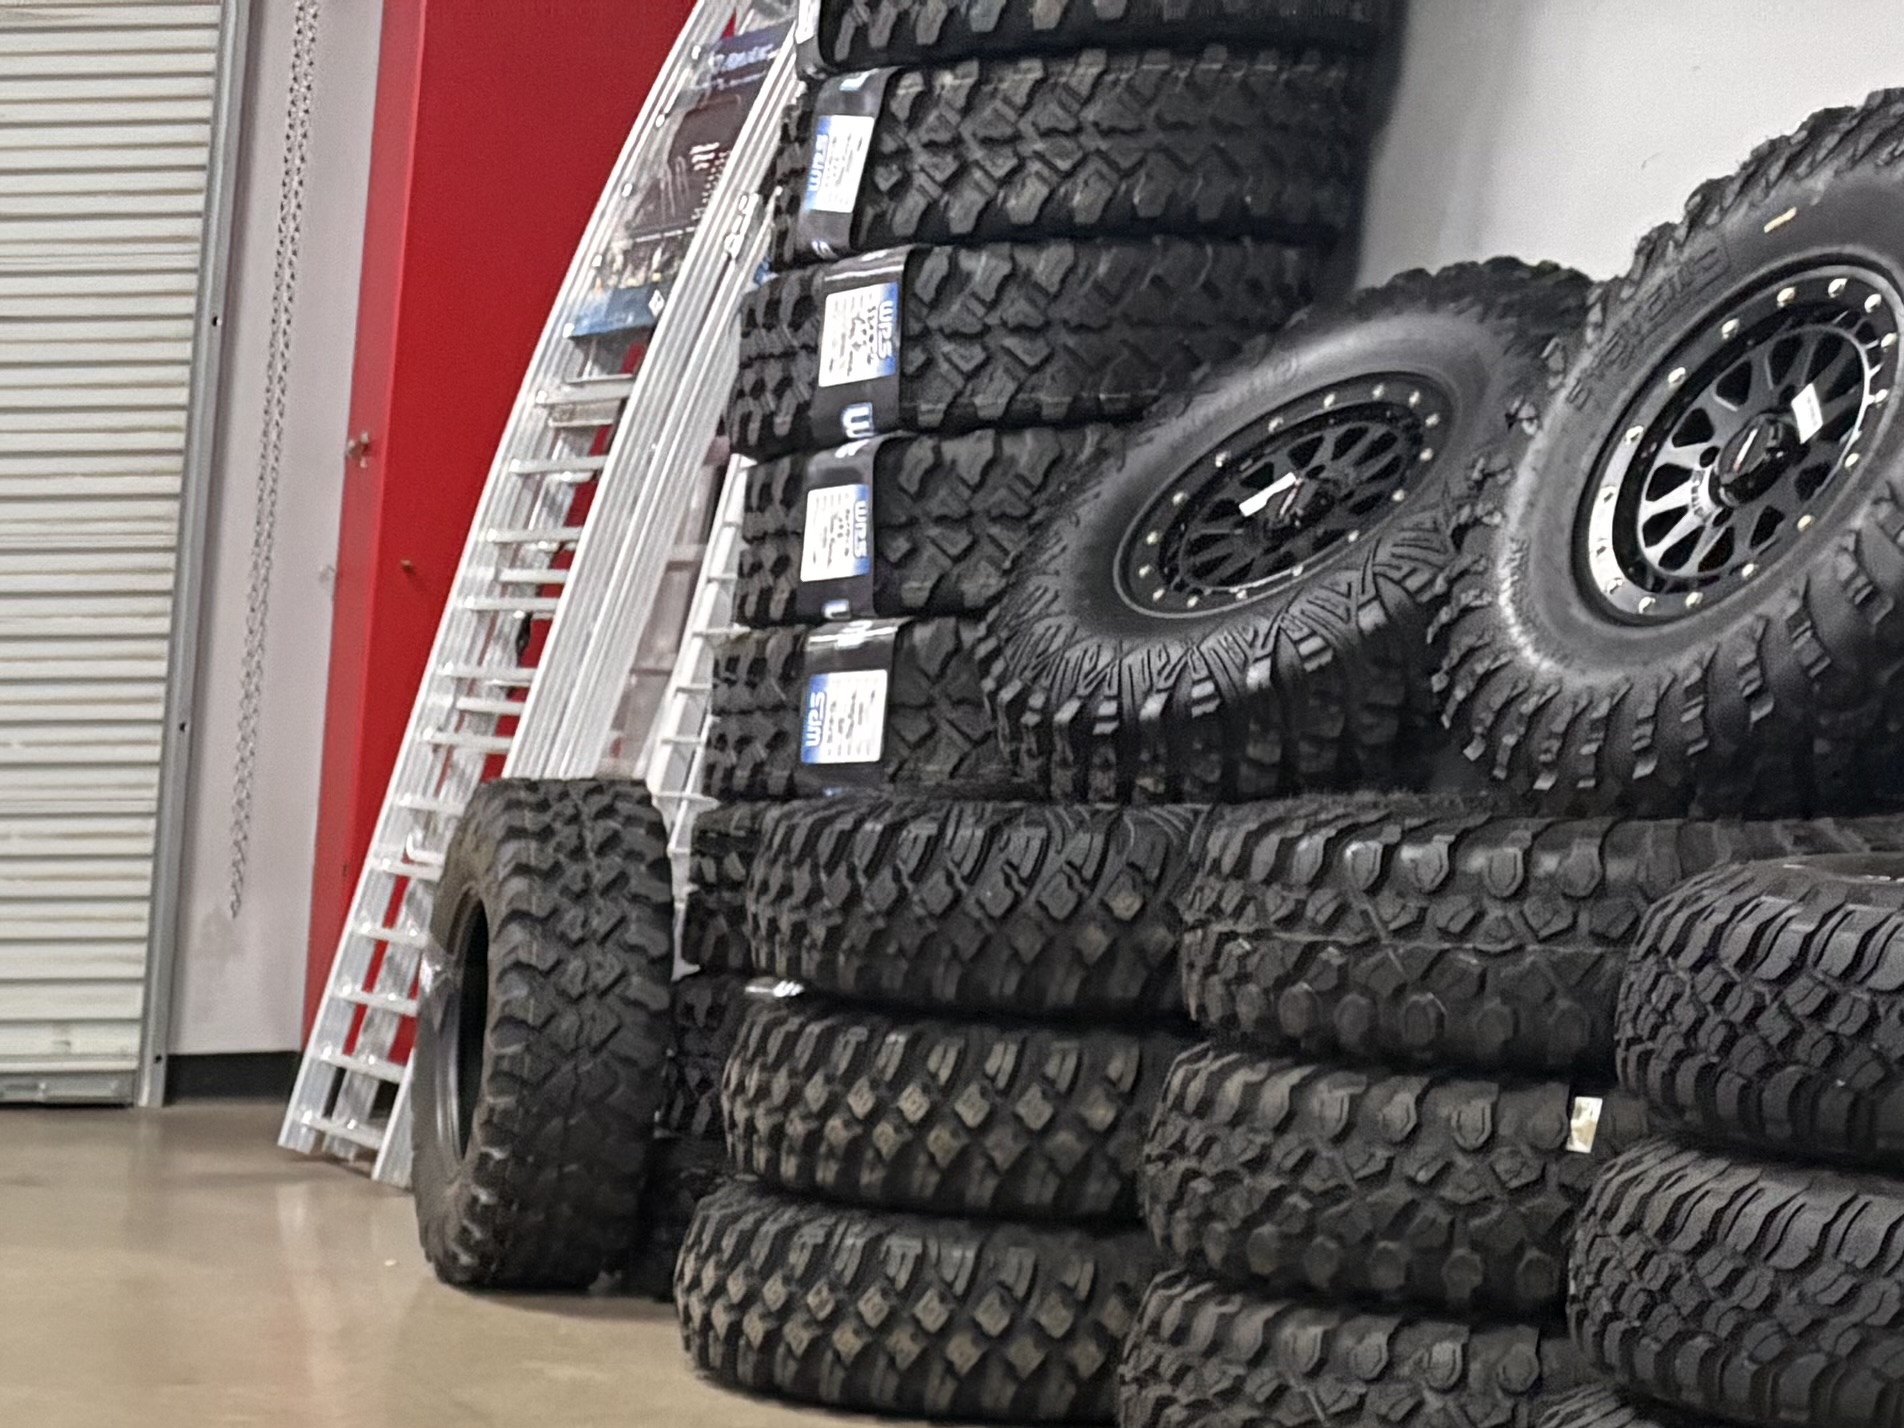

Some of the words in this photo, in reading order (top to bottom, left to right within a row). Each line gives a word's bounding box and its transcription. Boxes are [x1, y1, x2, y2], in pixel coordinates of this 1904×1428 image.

[876, 300, 894, 360] WPS
[853, 499, 869, 559] WPS
[805, 690, 826, 747] WPS
